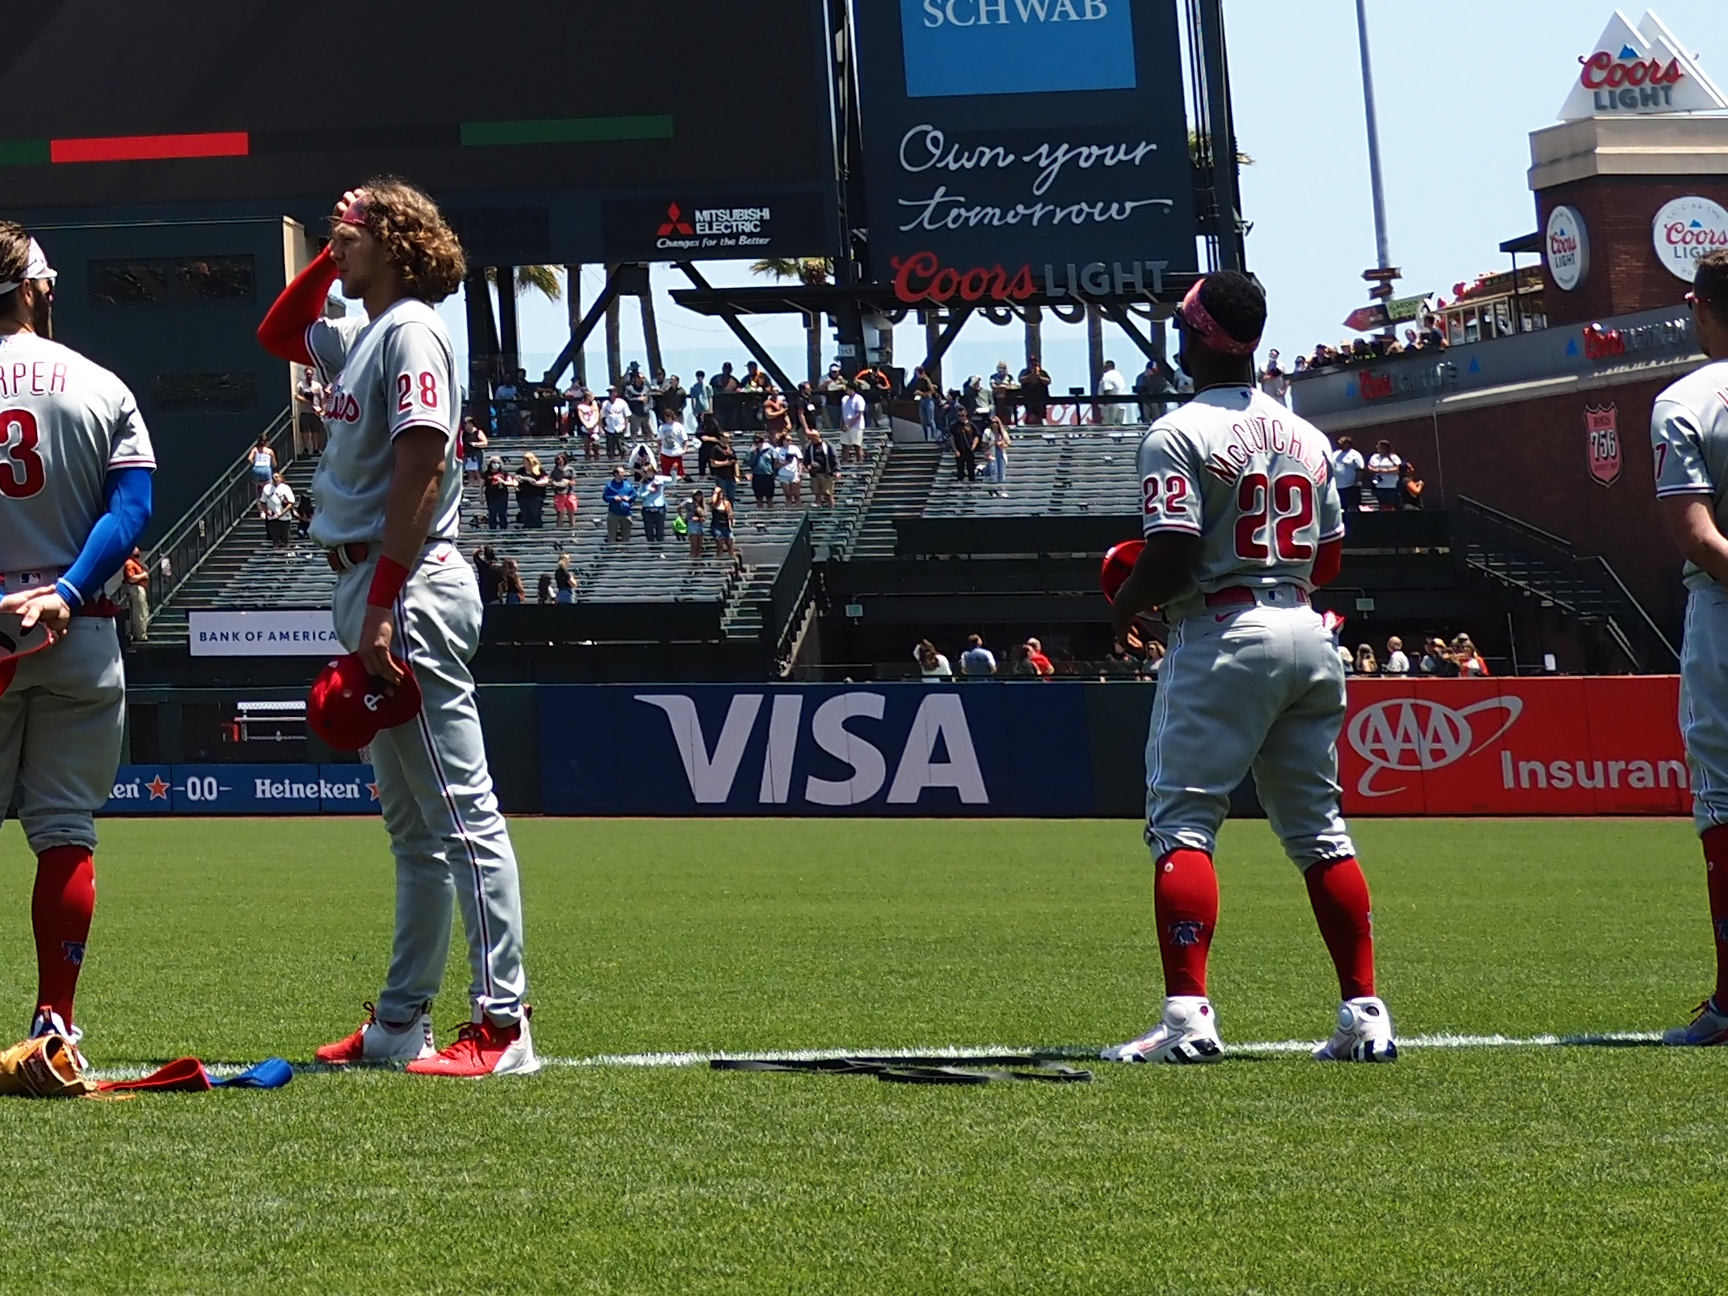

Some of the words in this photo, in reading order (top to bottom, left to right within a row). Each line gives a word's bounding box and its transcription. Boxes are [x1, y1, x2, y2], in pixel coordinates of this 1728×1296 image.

[1577, 51, 1684, 90] Coors
[1594, 85, 1673, 111] LIGHT
[899, 124, 1016, 173] Own
[1016, 139, 1159, 196] your
[694, 207, 771, 222] MITSUBISHI
[696, 220, 761, 235] ELECTRIC
[897, 185, 1175, 232] tomorrow
[1664, 221, 1728, 246] Coors
[891, 251, 1038, 304] Coors
[1045, 259, 1169, 298] LIGHT
[396, 371, 439, 415] 28
[1590, 429, 1617, 460] 756
[1143, 475, 1188, 516] 22
[1234, 471, 1315, 562] 22
[199, 630, 241, 643] BANK
[245, 630, 263, 643] OF
[267, 629, 338, 643] AMERICA
[633, 691, 990, 806] VISA
[1365, 703, 1458, 768] AAA
[186, 776, 218, 801] 0.0
[254, 778, 360, 800] Heineken
